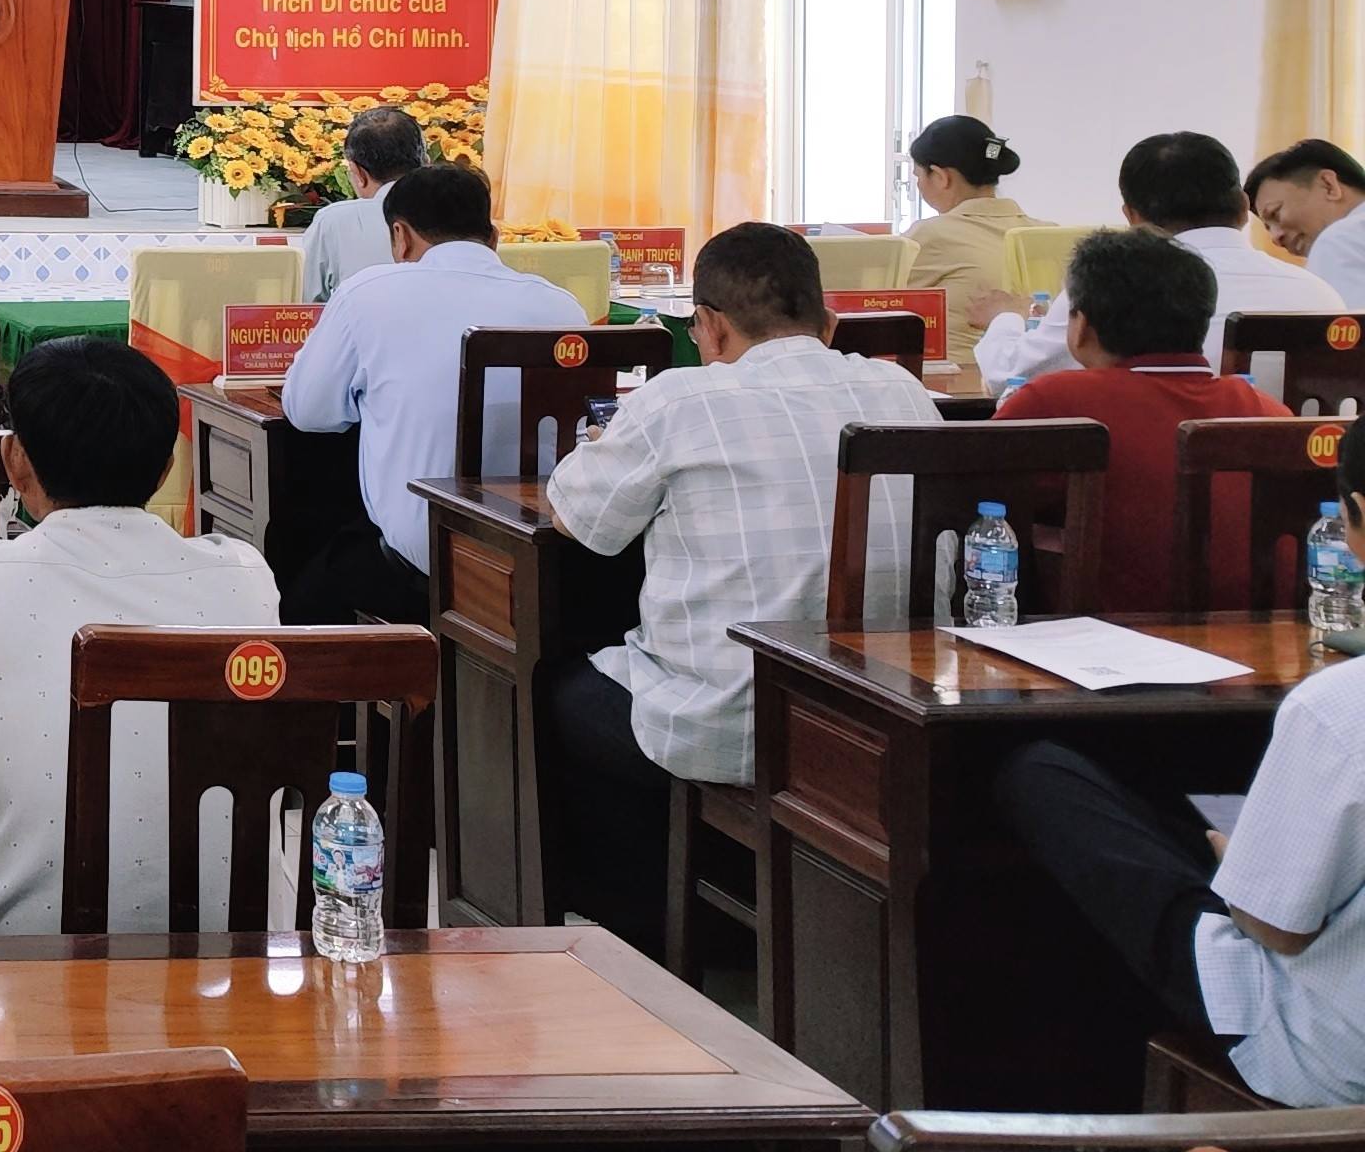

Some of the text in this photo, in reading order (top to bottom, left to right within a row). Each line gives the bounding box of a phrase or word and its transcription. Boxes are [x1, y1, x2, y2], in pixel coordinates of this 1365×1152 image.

[231, 321, 314, 345] NGUYỄN QUỐ
[1330, 325, 1356, 342] 010
[557, 341, 584, 361] 041
[231, 656, 278, 686] 095
